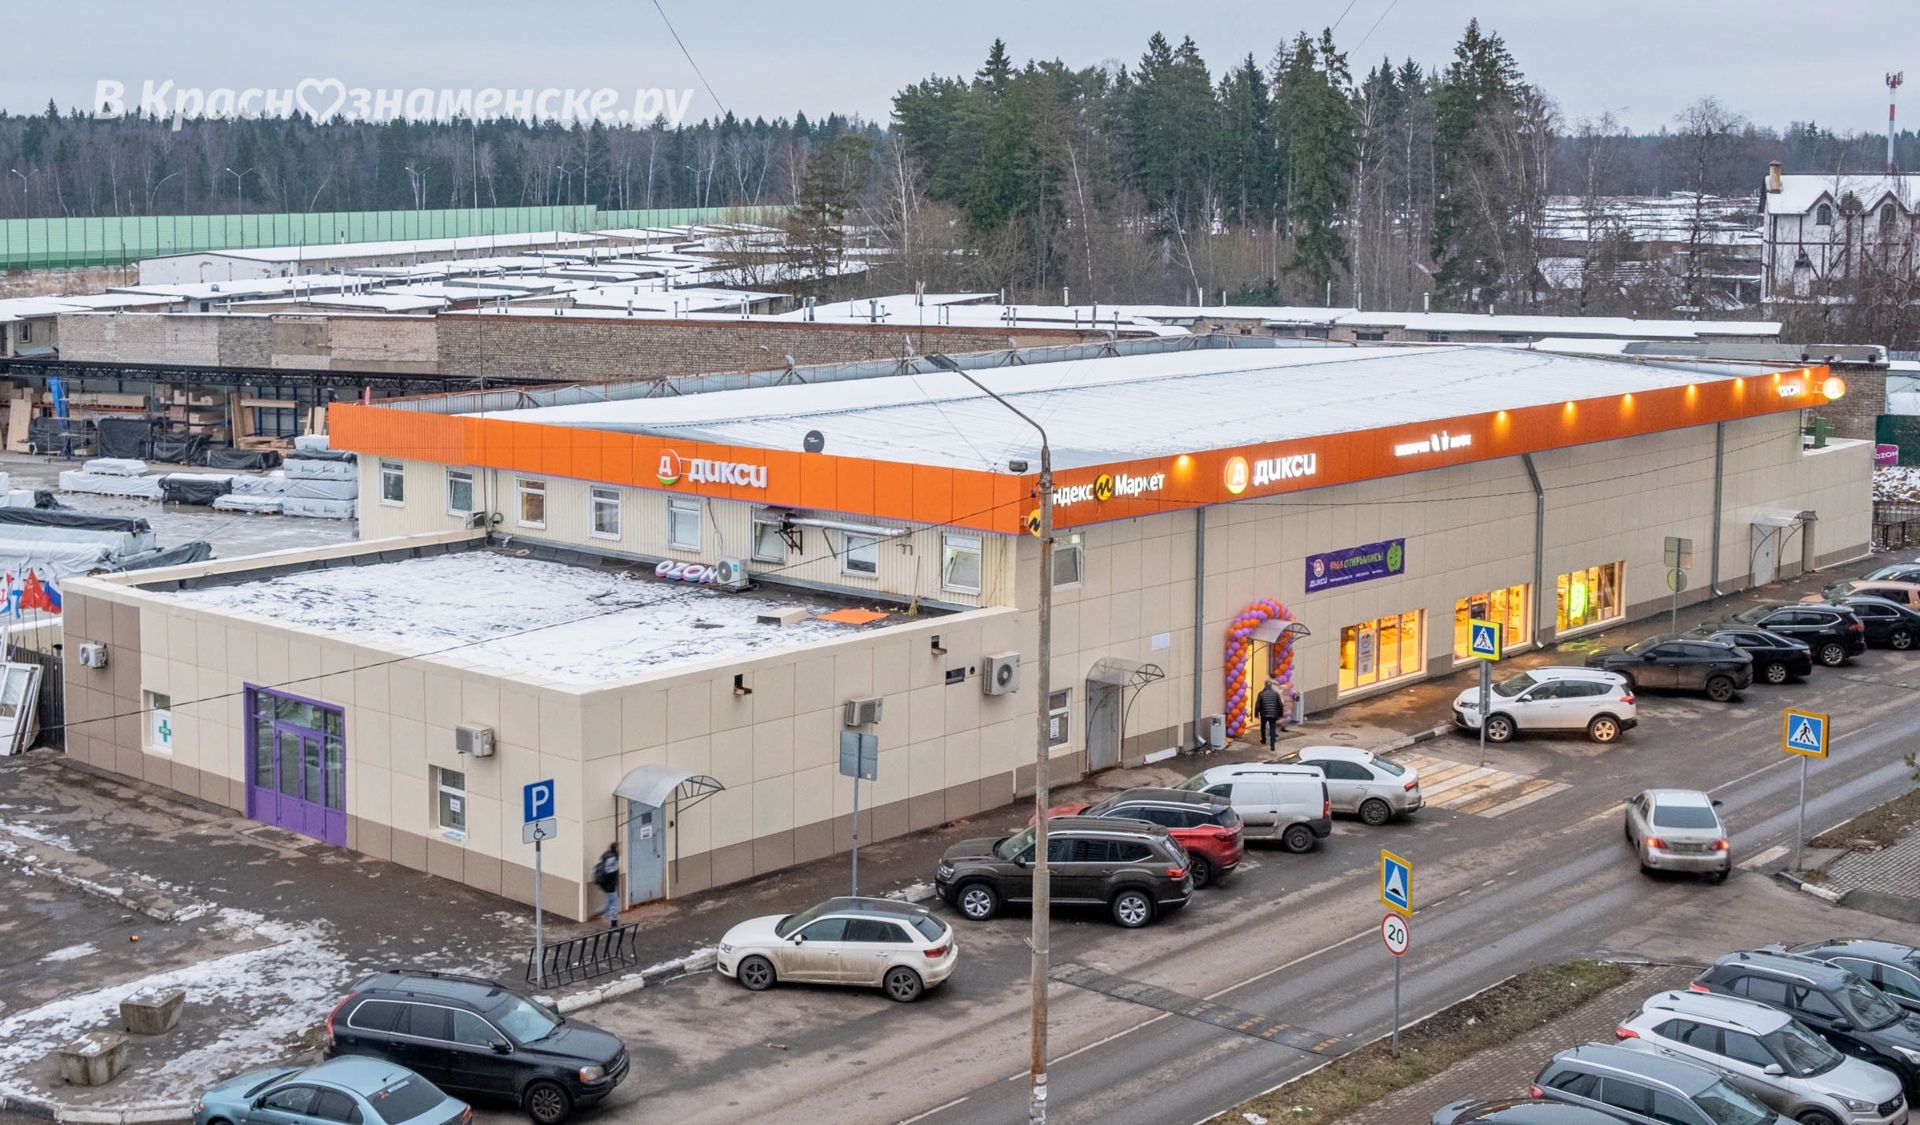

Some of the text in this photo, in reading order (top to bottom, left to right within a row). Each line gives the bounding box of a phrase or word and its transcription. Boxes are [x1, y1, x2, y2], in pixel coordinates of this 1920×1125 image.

[688, 459, 768, 488] ДИКСИ
[1252, 453, 1316, 486] ДИКСИ
[1051, 484, 1094, 507] ндекс
[1114, 473, 1165, 497] Маркет
[656, 560, 718, 584] OZON
[532, 785, 550, 818] P
[1388, 924, 1404, 945] 20
